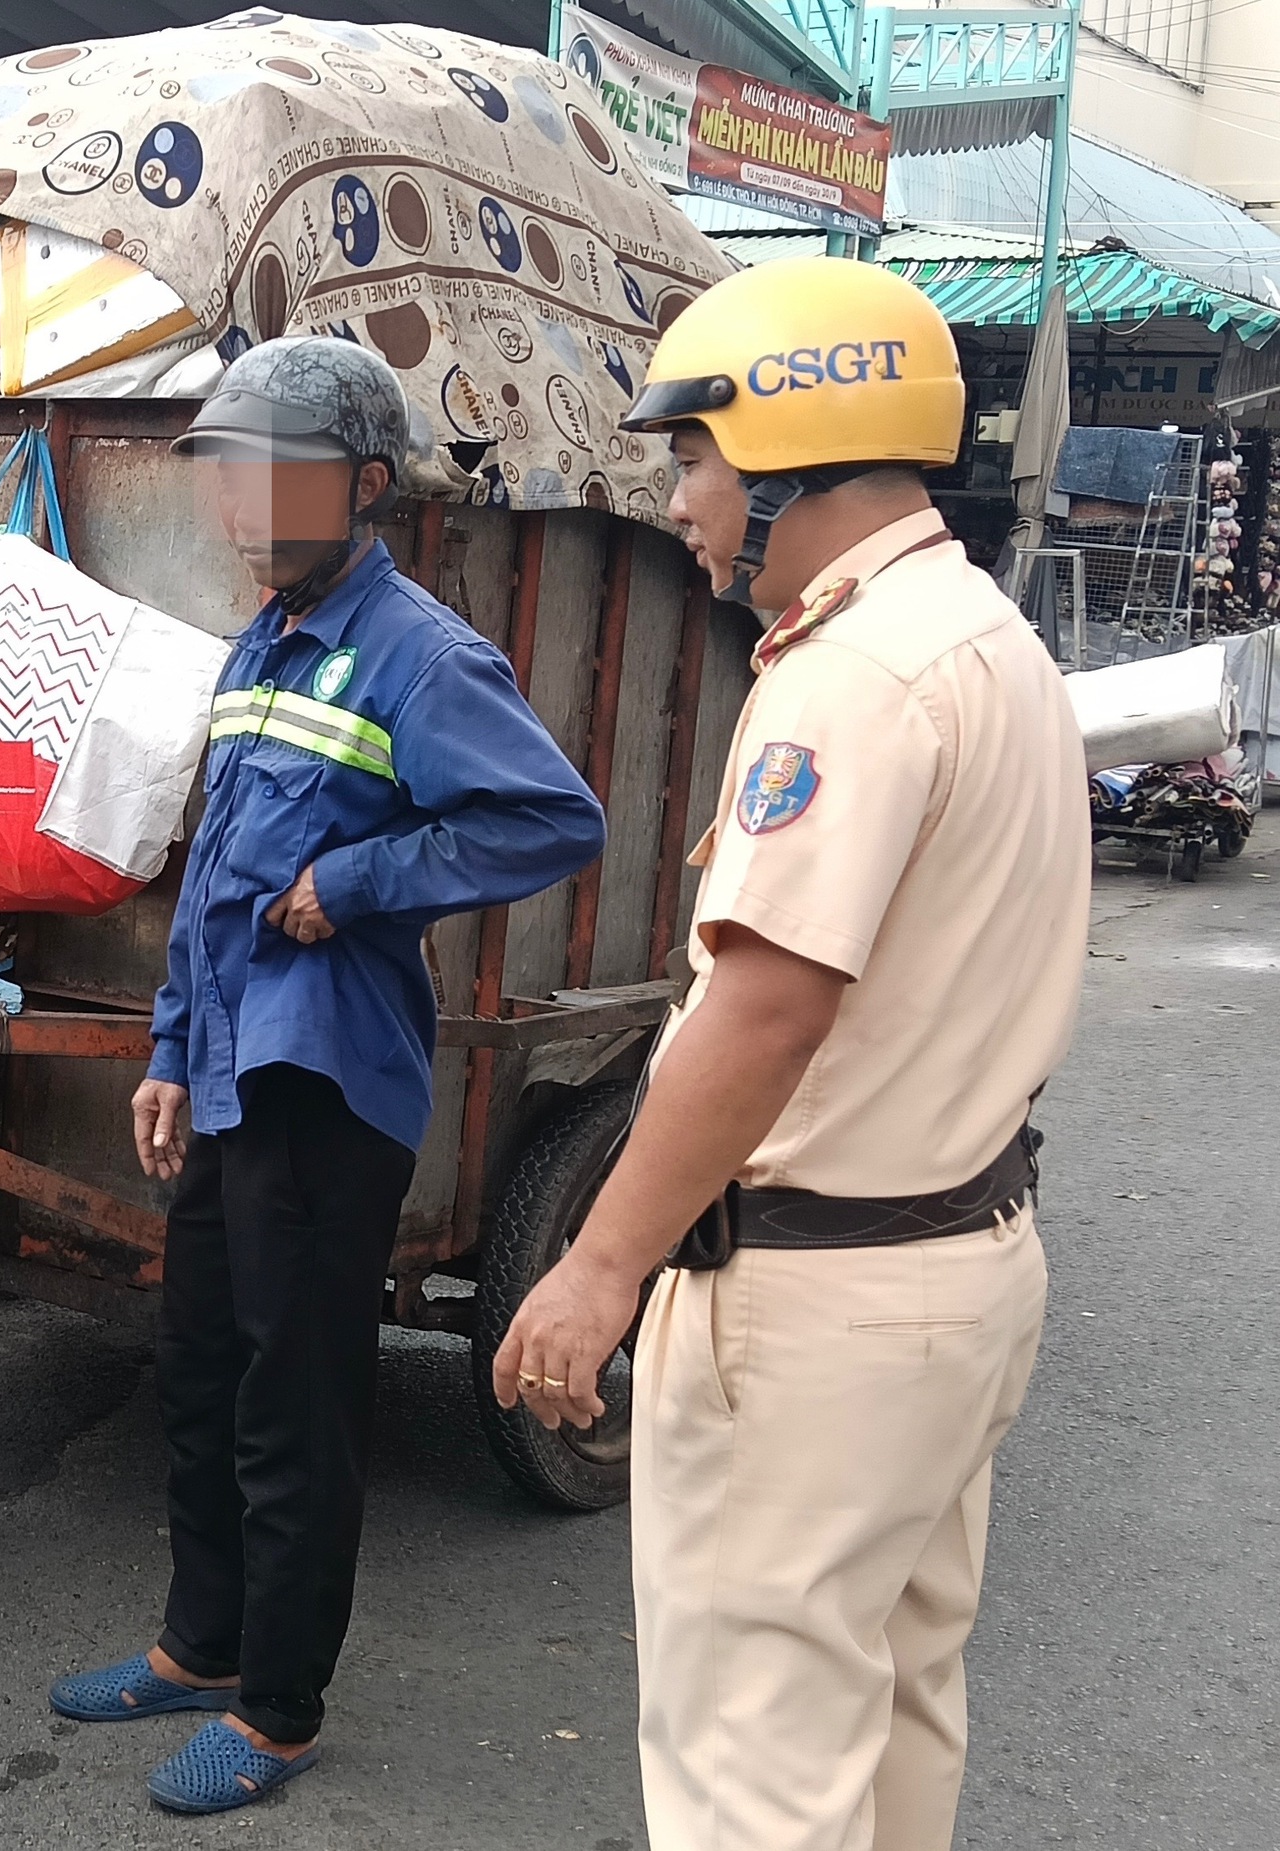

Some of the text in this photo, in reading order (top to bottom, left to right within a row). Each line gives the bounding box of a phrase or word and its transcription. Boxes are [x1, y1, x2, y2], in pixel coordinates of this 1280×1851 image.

[644, 91, 687, 152] VIỆT
[778, 96, 805, 121] KHAI
[277, 140, 321, 177] CHANEL
[335, 136, 388, 153] CHANEL
[741, 117, 771, 161] PHÍ
[771, 128, 820, 175] KHÁM
[443, 183, 459, 254] CHANEL
[614, 233, 669, 266] CHANEL
[305, 293, 348, 320] CHANEL
[364, 276, 421, 302] CHANEL
[748, 341, 906, 396] CSGT
[456, 370, 490, 436] CHANEL
[554, 379, 587, 445] CHANEL
